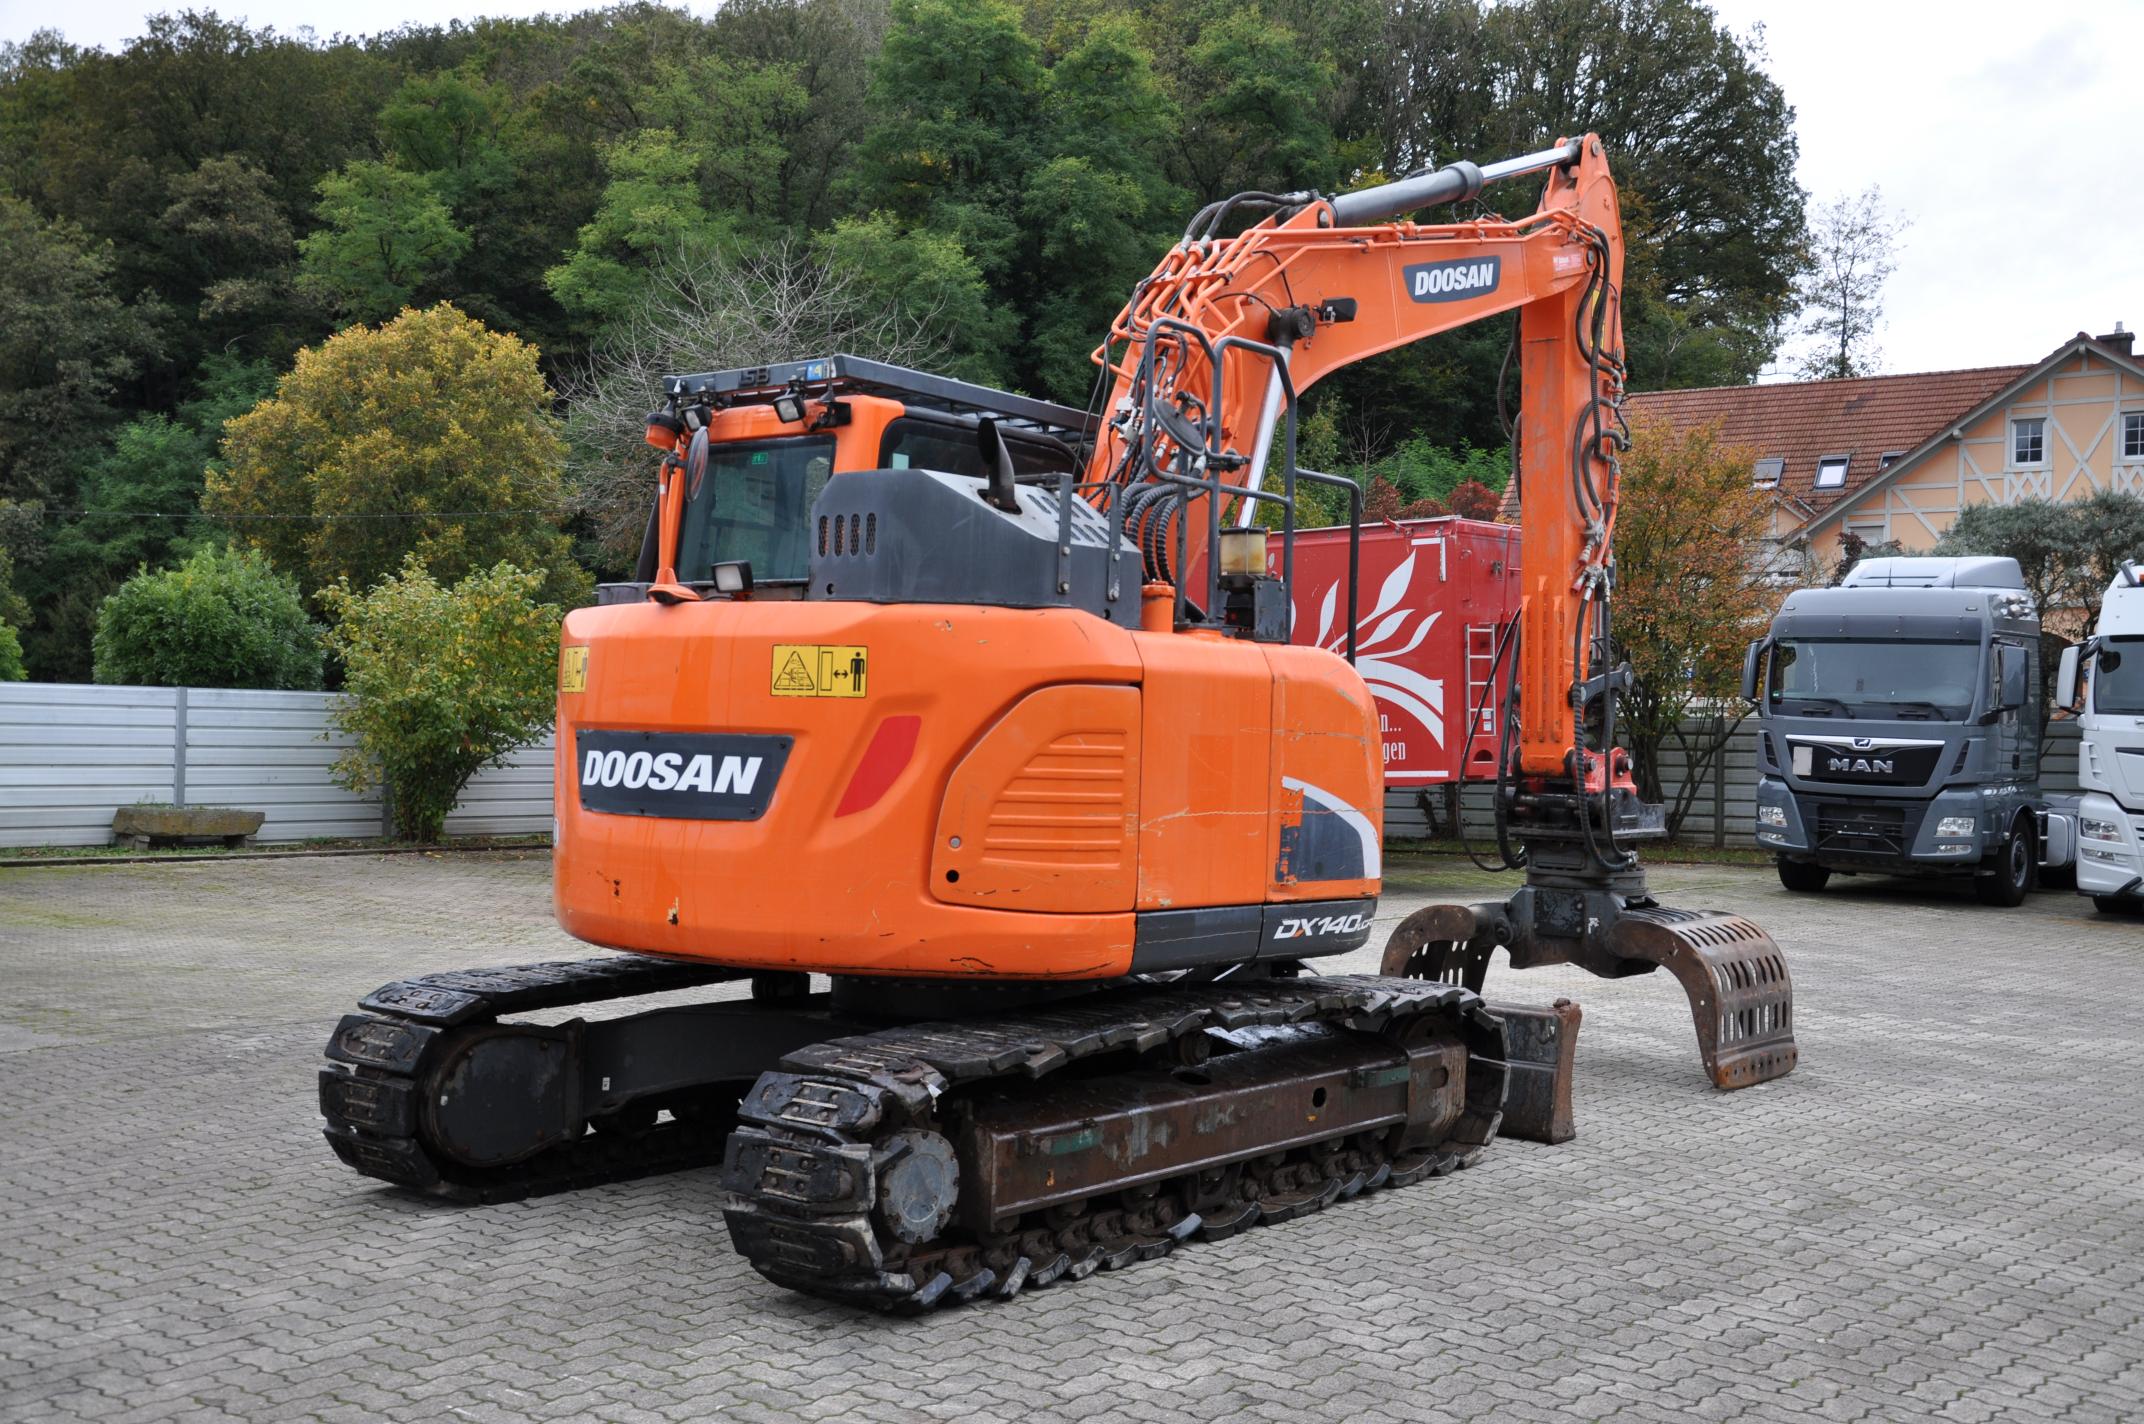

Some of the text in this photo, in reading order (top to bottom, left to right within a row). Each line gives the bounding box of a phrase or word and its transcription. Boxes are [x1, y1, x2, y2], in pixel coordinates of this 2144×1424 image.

[1415, 263, 1494, 296] DOOSAN
[582, 750, 763, 794] DOOSAN
[1829, 758, 1893, 773] MAN
